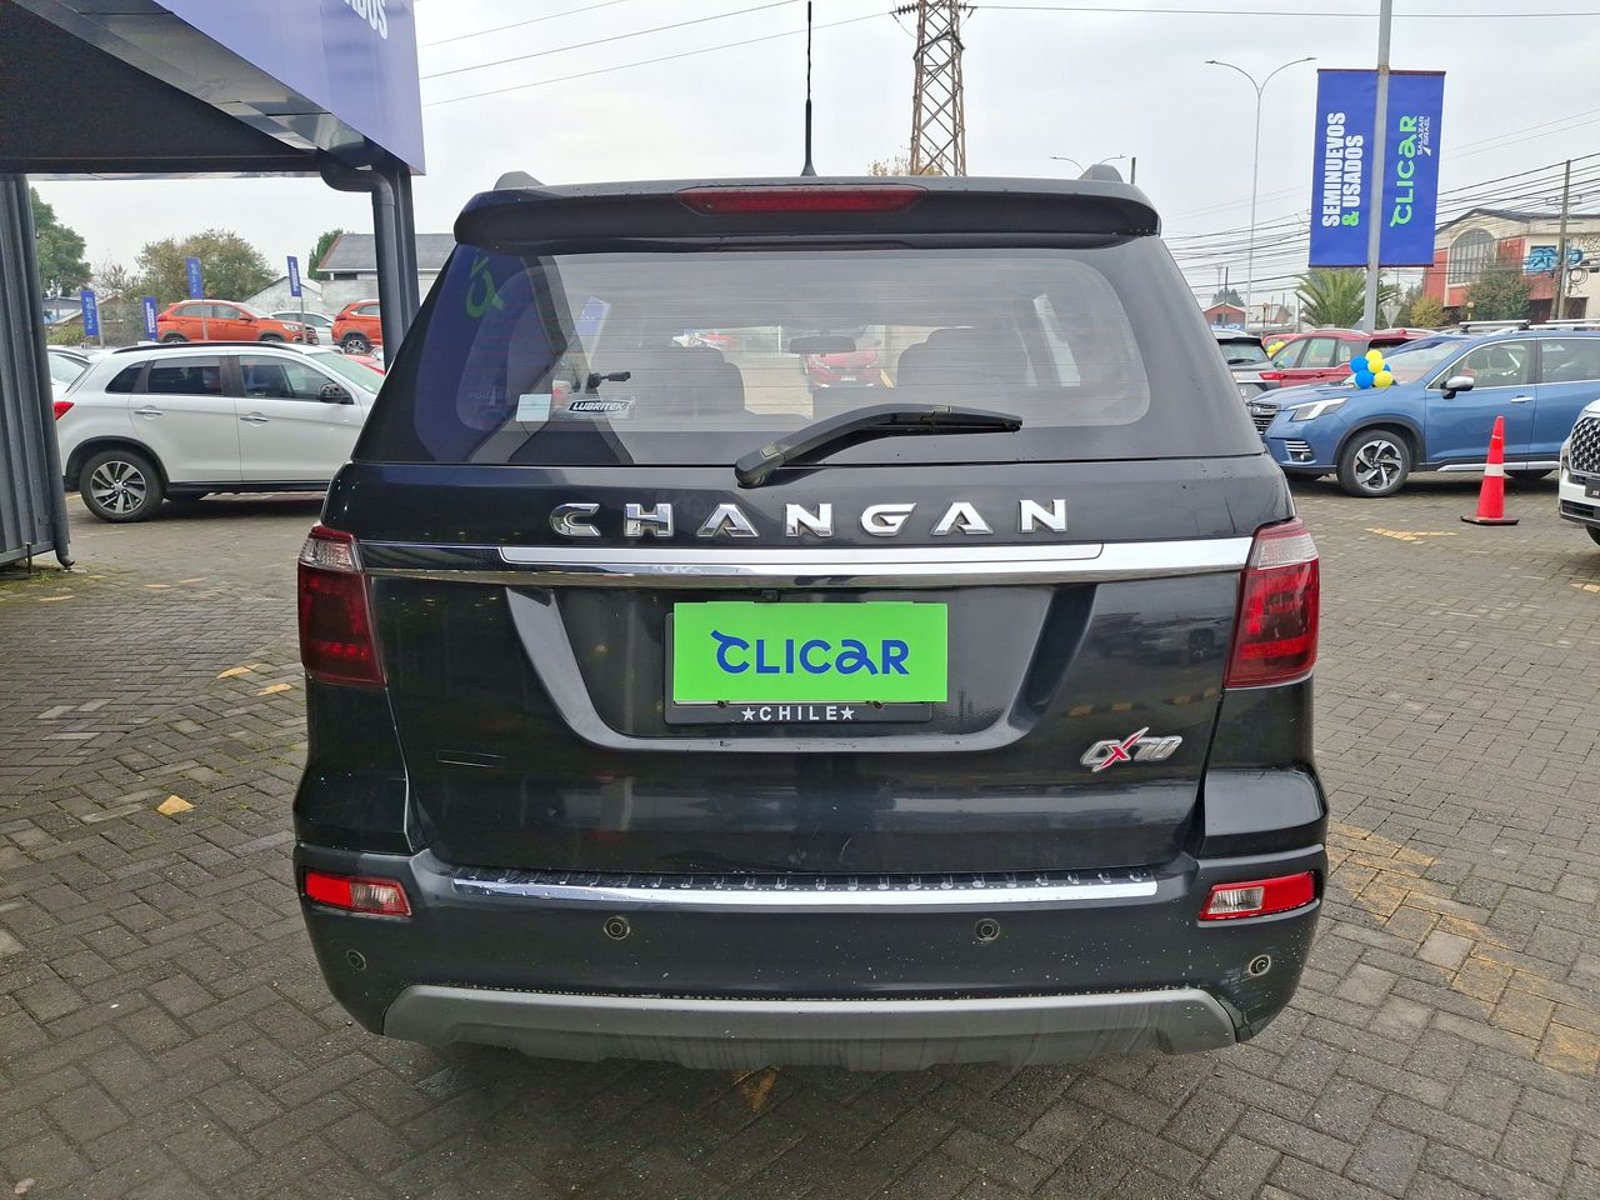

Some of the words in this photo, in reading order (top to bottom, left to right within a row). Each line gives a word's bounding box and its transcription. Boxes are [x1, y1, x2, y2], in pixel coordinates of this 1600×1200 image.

[1321, 112, 1346, 228] SEMINUEVOS
[1342, 135, 1364, 207] USADOS
[1341, 211, 1360, 227] &
[549, 499, 1067, 537] CHANGAN
[759, 706, 838, 721] CHILE
[1080, 726, 1183, 773] CX70
